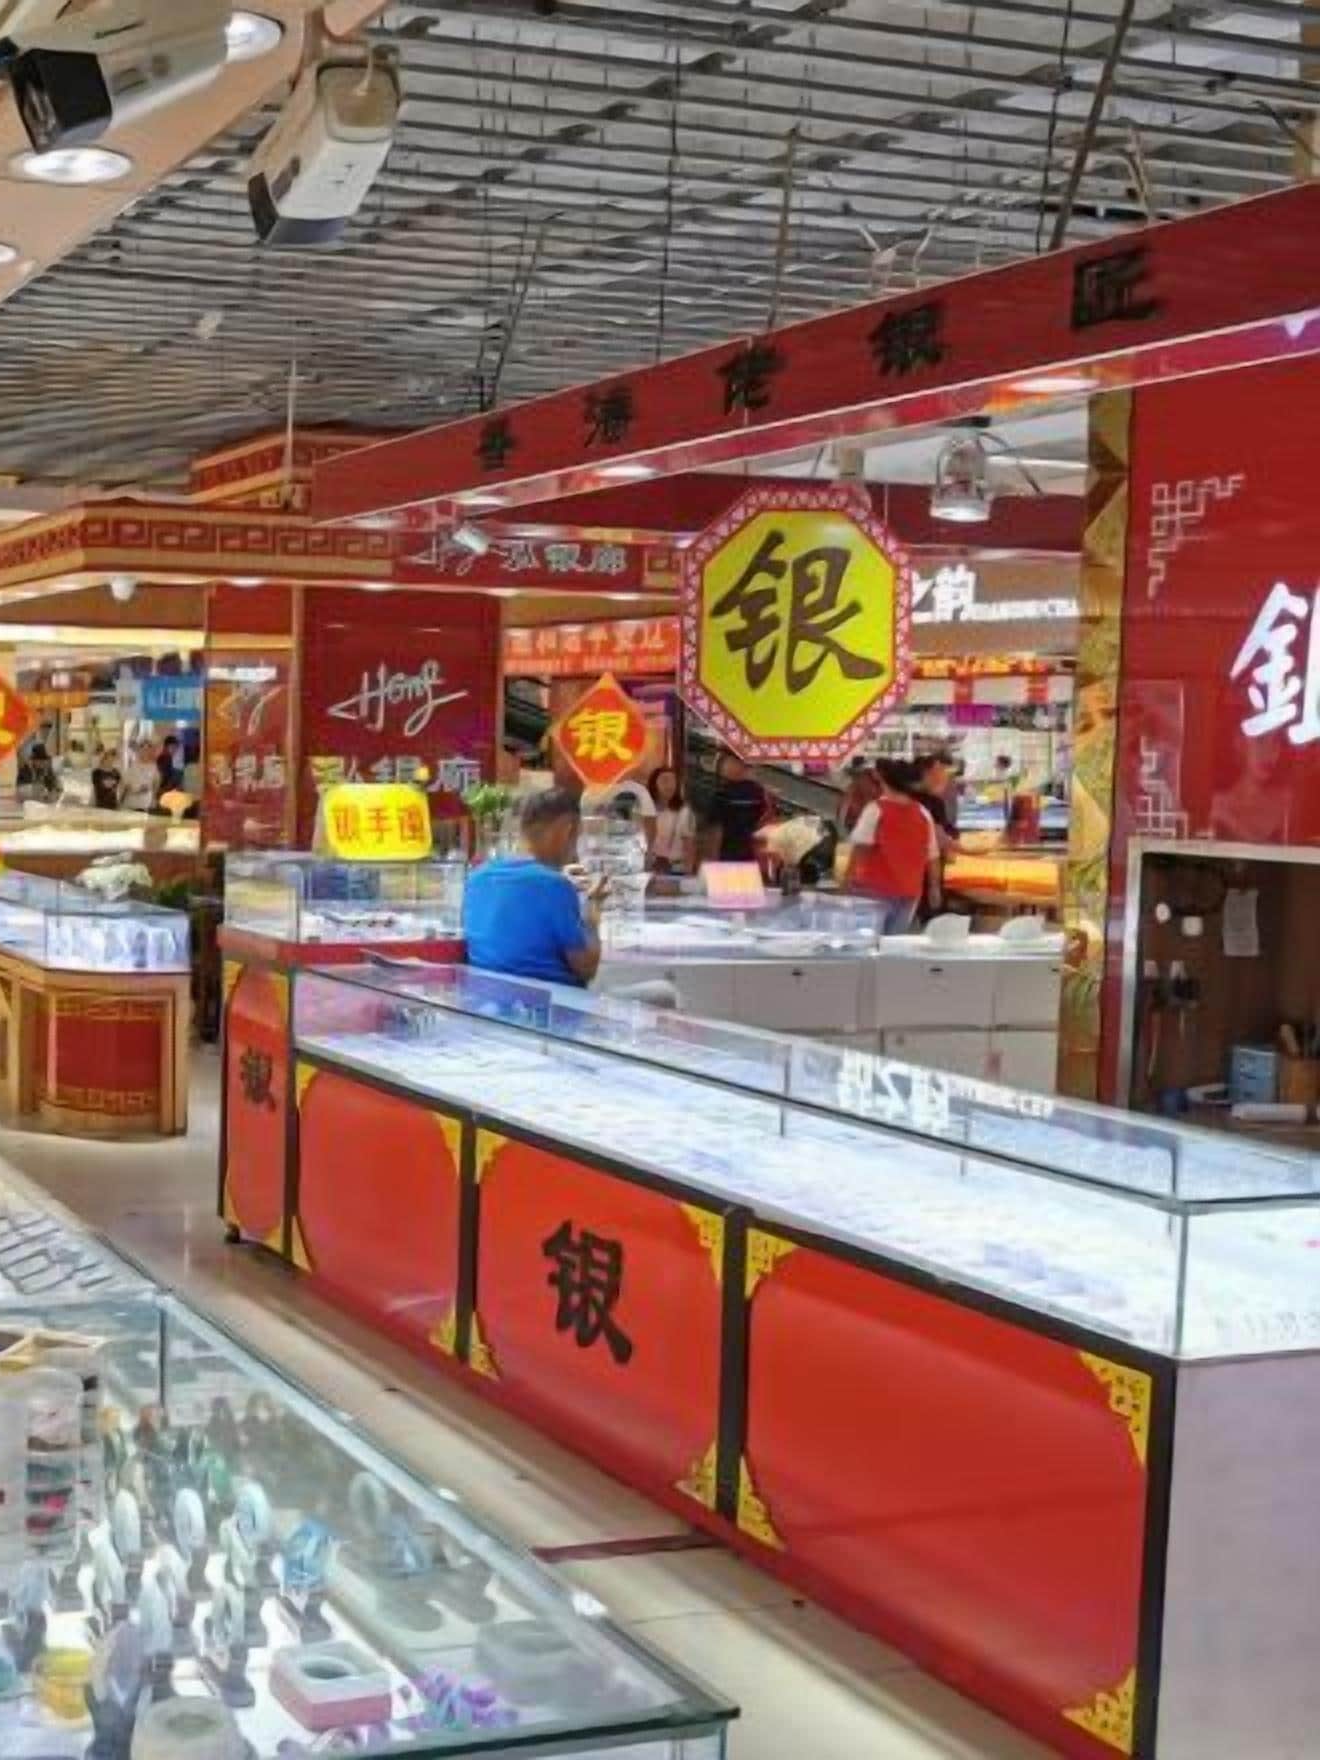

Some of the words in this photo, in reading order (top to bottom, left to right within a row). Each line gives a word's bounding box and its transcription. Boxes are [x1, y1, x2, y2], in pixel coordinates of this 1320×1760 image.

[710, 529, 886, 695] 银
[567, 706, 633, 761] 银
[541, 1219, 635, 1366] 银
